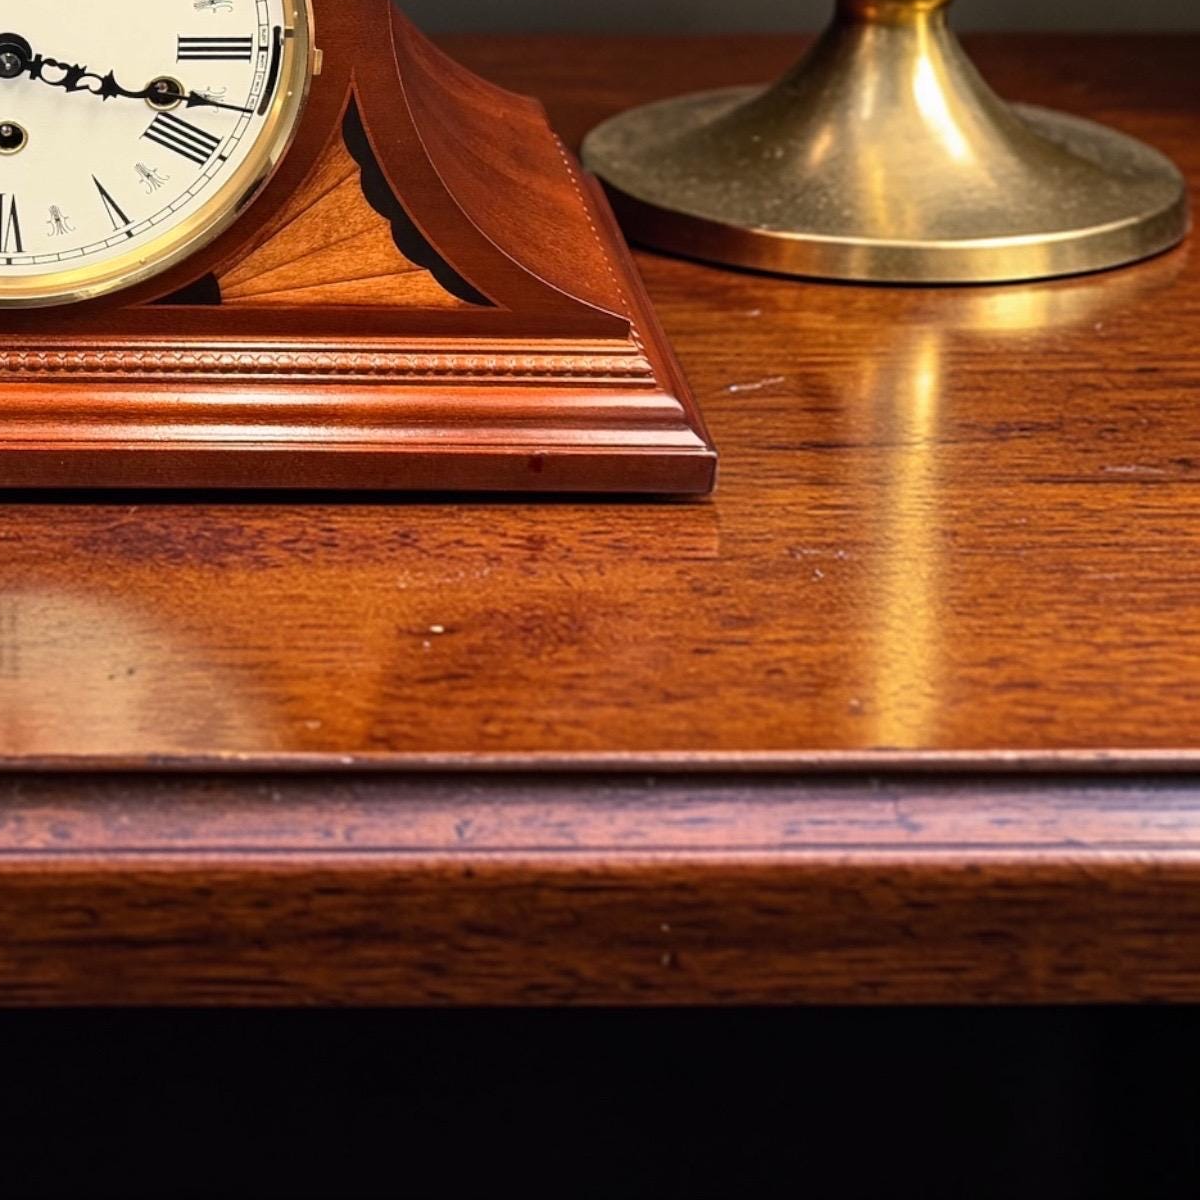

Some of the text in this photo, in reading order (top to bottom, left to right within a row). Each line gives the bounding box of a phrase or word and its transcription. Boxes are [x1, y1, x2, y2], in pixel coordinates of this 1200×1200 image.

[176, 34, 253, 64] III
[139, 112, 224, 169] IIII
[92, 174, 134, 232] V
